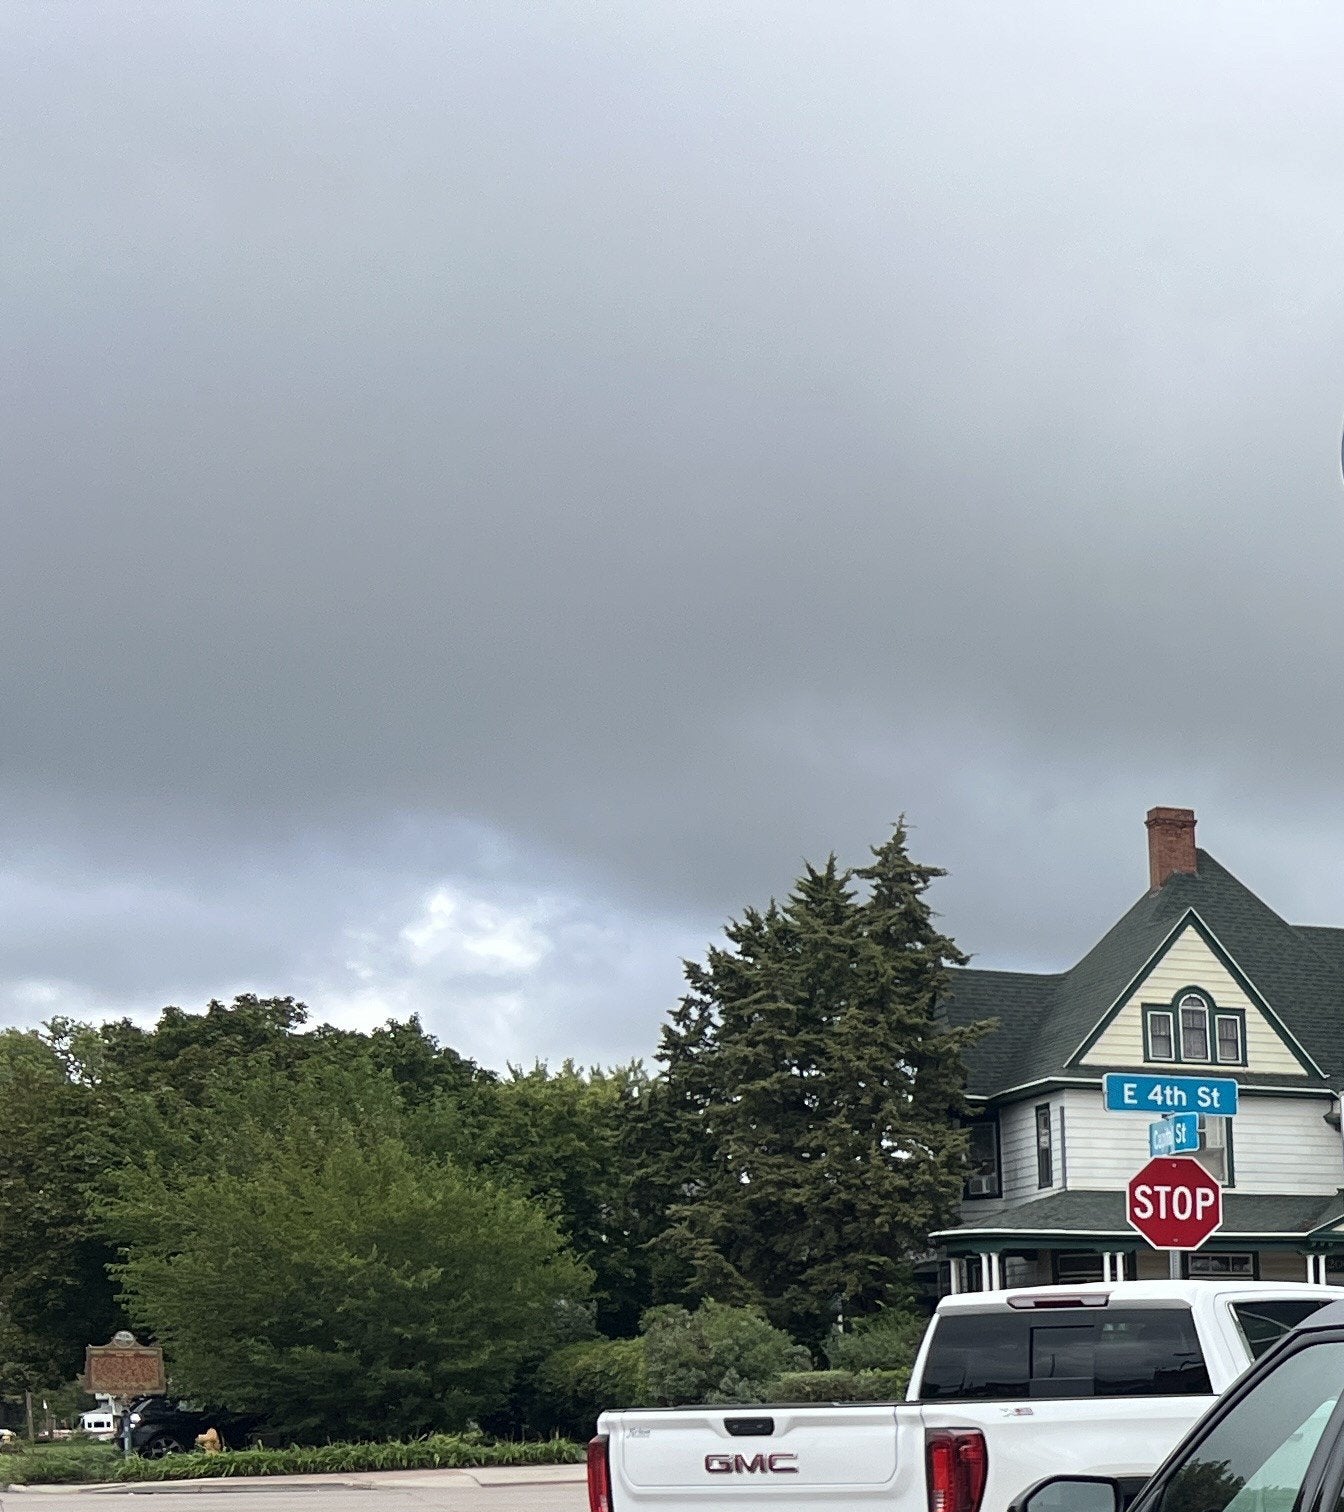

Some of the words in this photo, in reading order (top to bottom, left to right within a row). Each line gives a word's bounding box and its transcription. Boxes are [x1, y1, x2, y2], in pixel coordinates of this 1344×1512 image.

[1123, 1083, 1138, 1105] E
[1147, 1084, 1187, 1107] 4th
[1197, 1087, 1221, 1108] St
[1175, 1122, 1187, 1144] St
[1134, 1184, 1216, 1222] STOP
[704, 1453, 799, 1475] GMC
